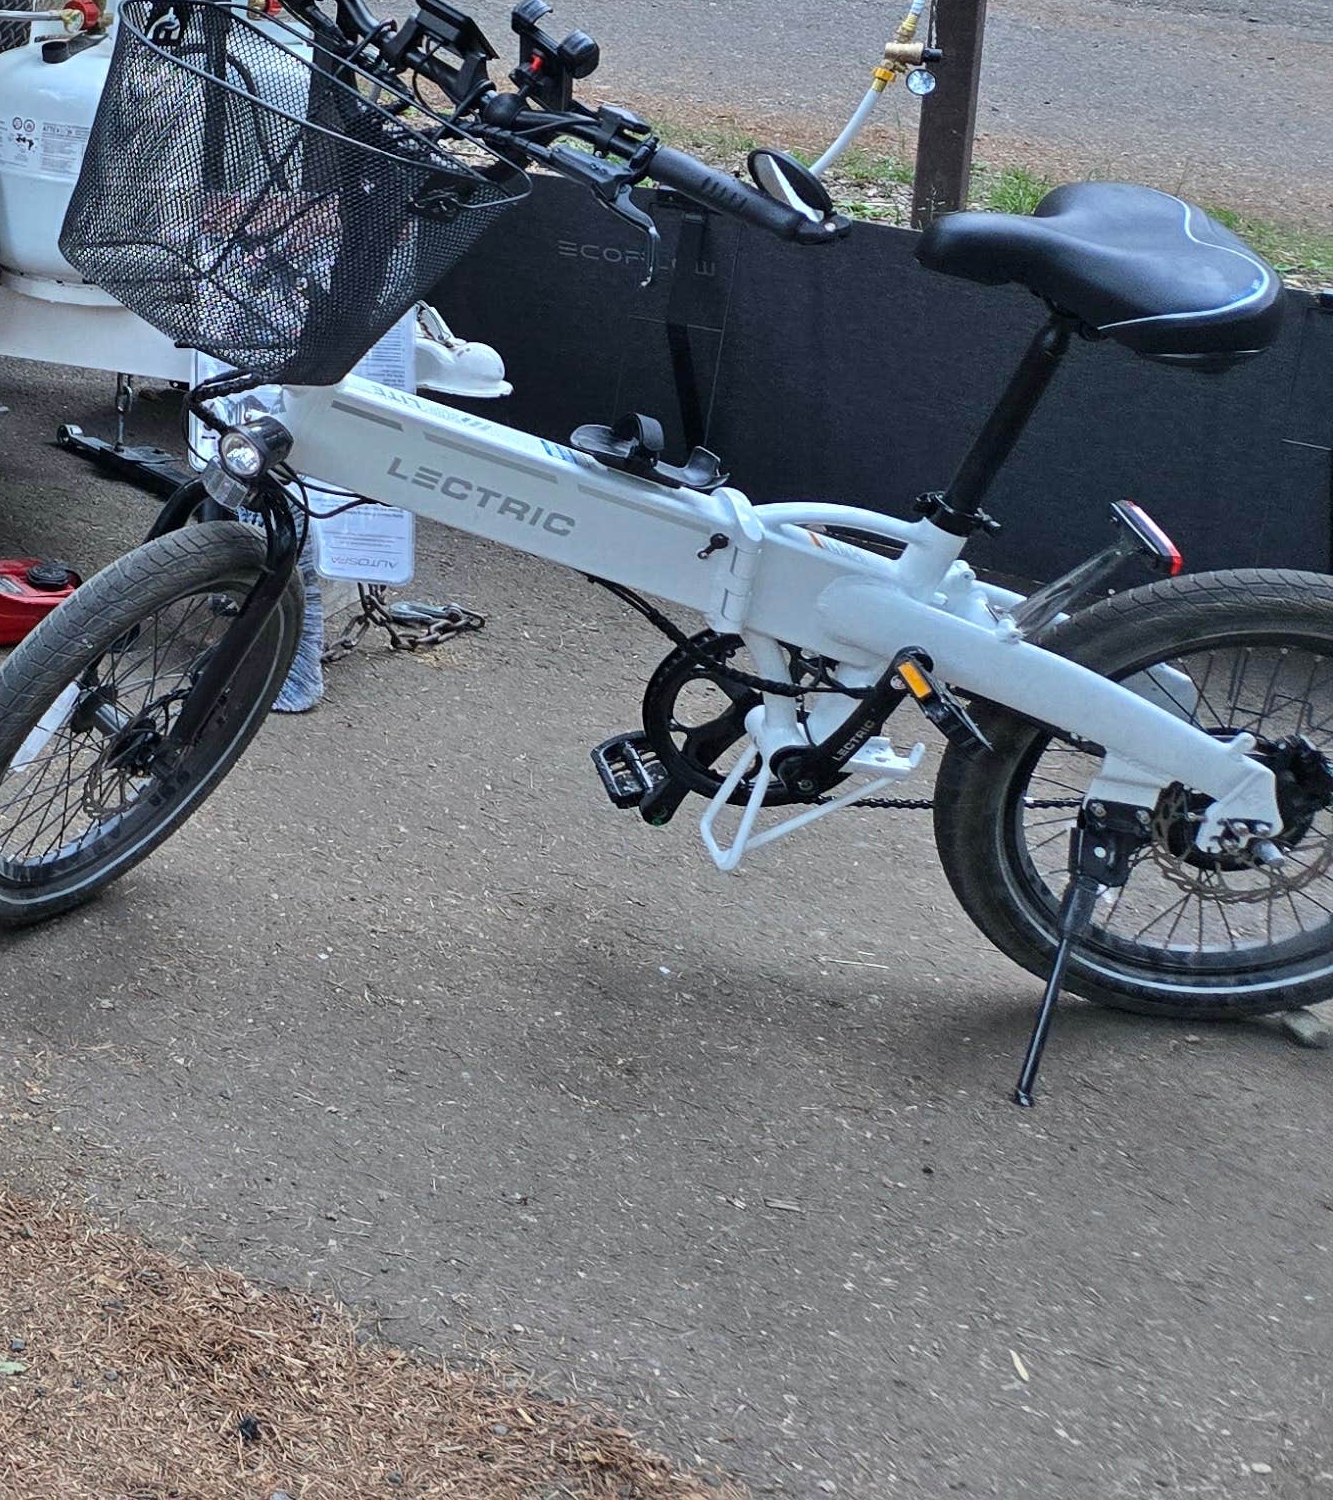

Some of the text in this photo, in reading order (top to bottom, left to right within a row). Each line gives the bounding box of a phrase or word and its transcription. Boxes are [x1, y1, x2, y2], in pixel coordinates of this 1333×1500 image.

[557, 239, 716, 277] ECOFW
[386, 456, 576, 537] LECTRIC
[831, 720, 875, 762] LECTRIC
